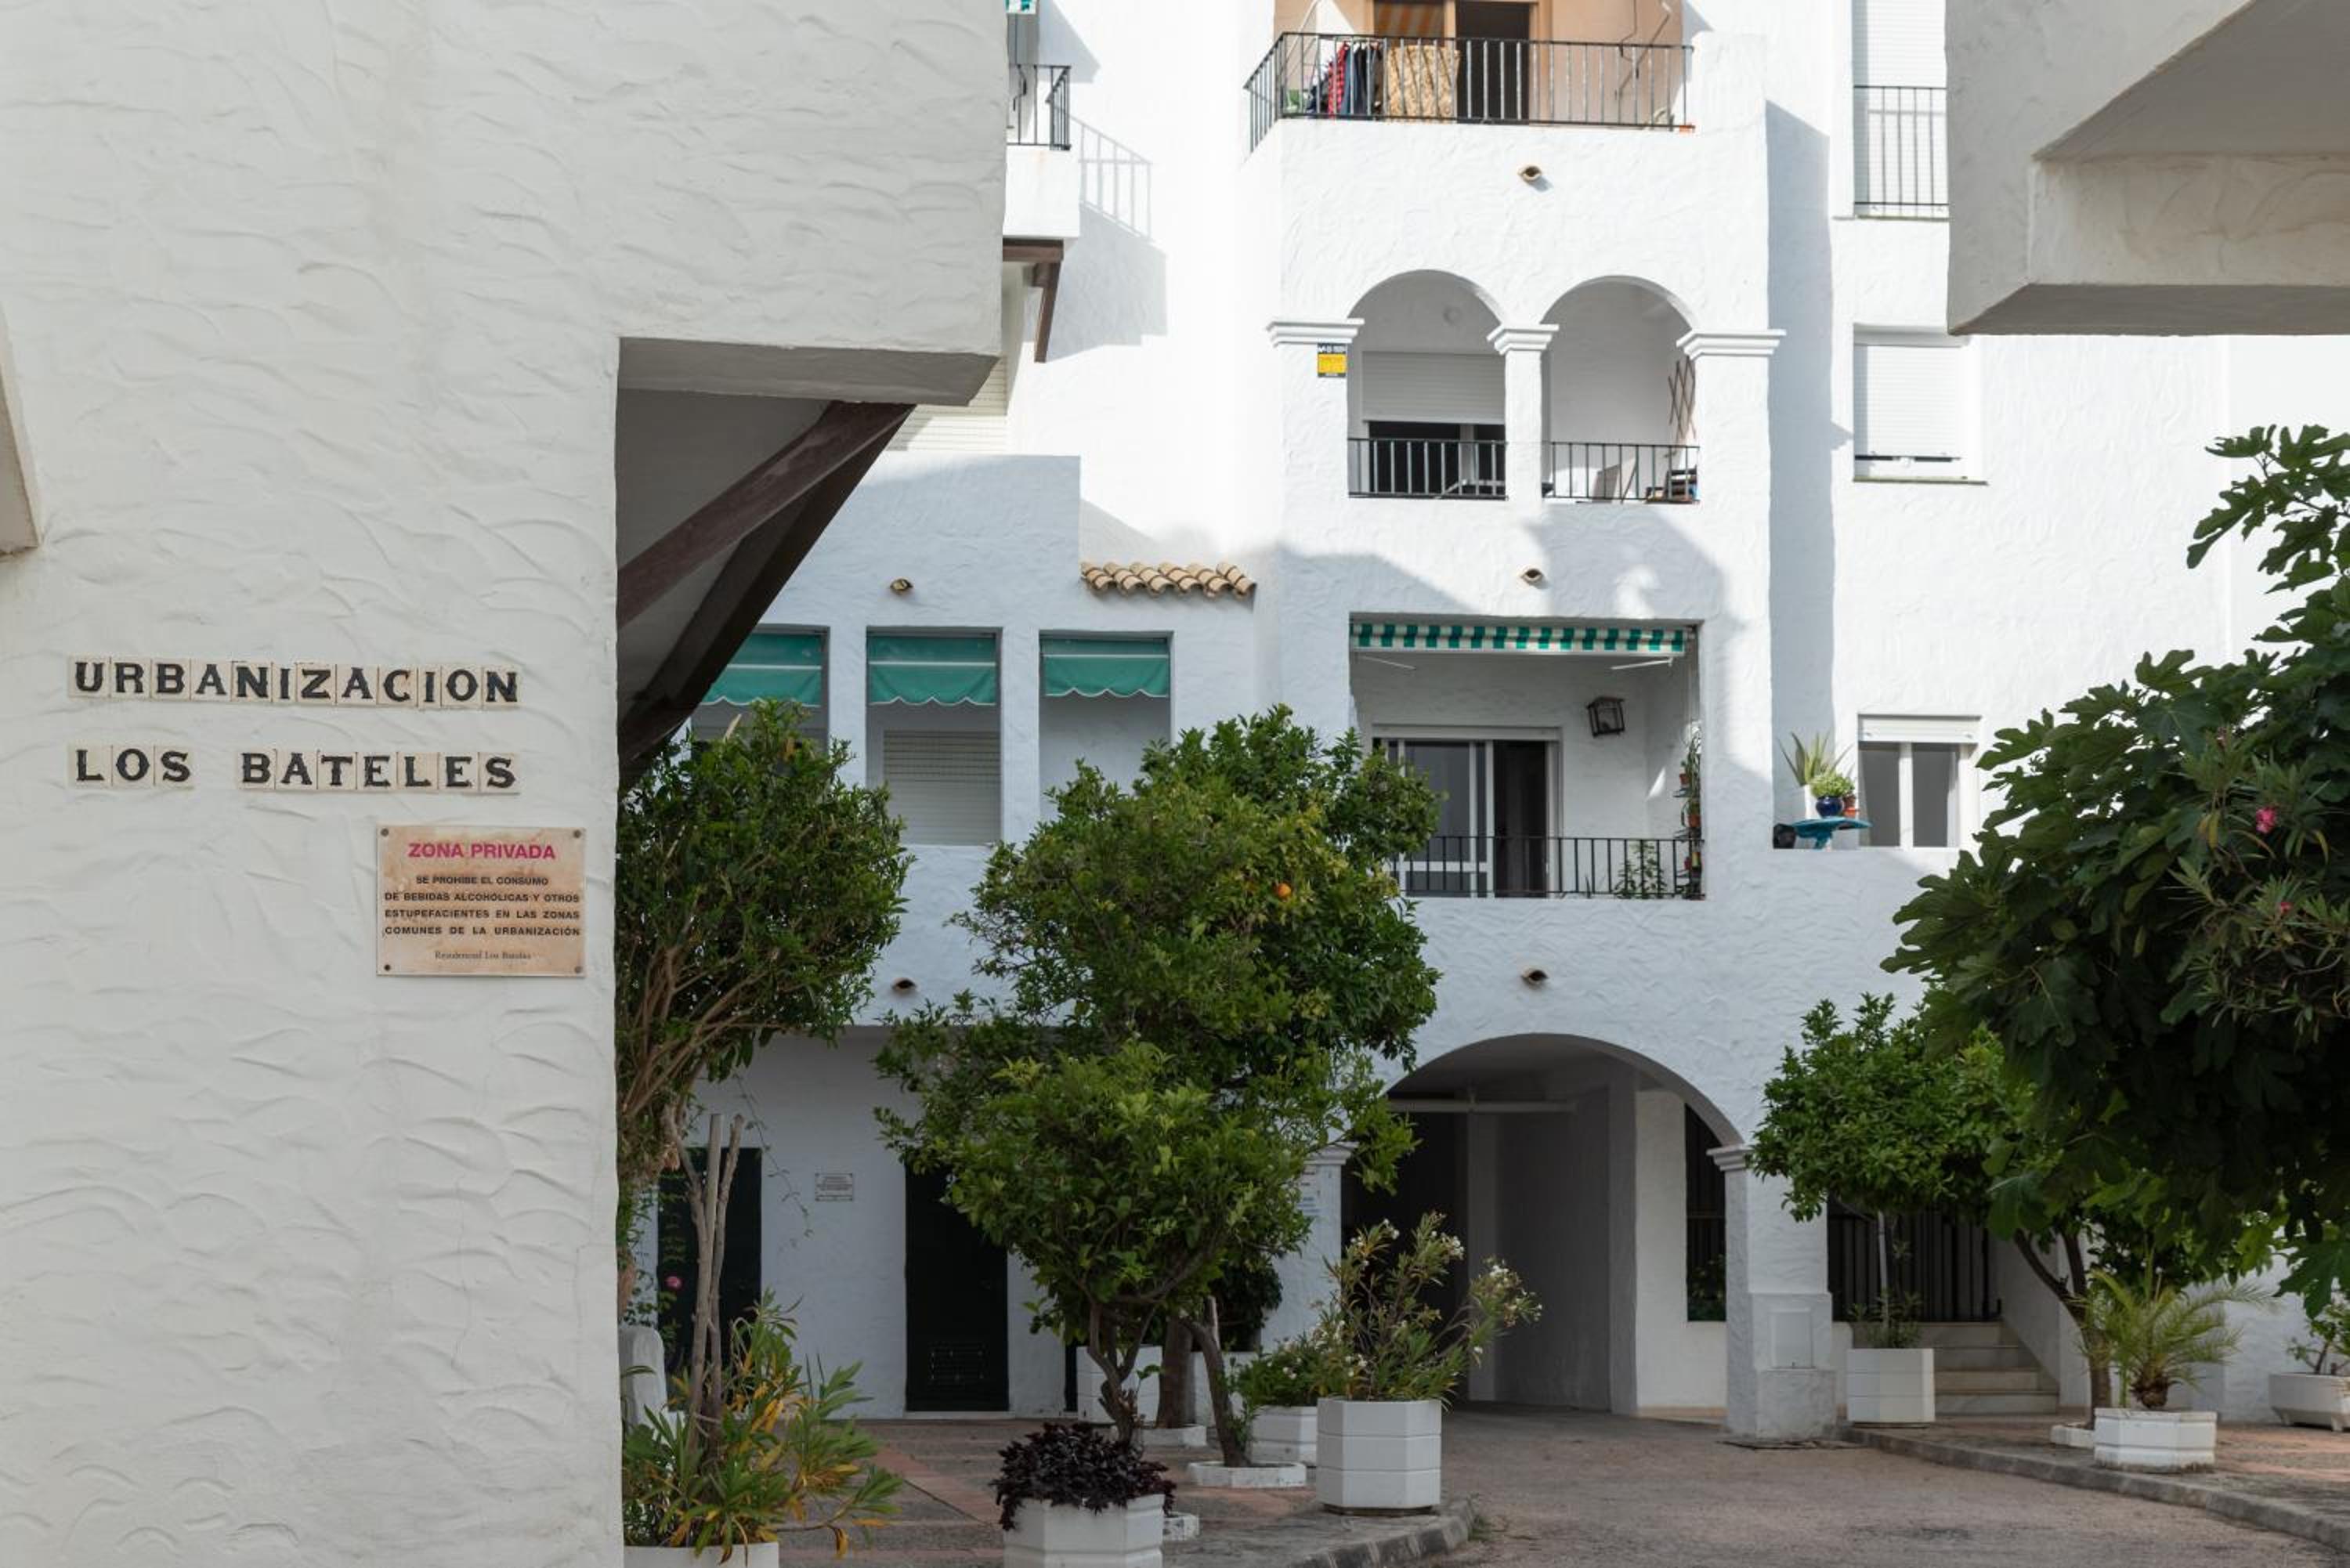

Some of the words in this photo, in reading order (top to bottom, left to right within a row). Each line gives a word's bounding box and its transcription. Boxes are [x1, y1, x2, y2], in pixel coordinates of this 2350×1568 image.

[75, 662, 518, 703] URBANIZACION
[76, 748, 191, 782] LOS
[241, 752, 515, 789] BATELES
[408, 843, 465, 858] ZONA
[471, 844, 556, 859] PRIVADA
[416, 876, 429, 884] SE
[496, 876, 549, 886] CONSUMO
[385, 892, 400, 901] DE
[403, 893, 450, 901] BEBIDAS
[454, 891, 529, 901] ALCOHÓLICAS
[533, 894, 540, 902] Y
[544, 894, 580, 903] OTROS
[385, 909, 490, 919] ESTUPEFACIENTES
[496, 909, 510, 919] EN
[516, 910, 537, 919] LAS
[543, 911, 580, 919] ZONAS
[494, 925, 580, 936] URBANIZACIÓN
